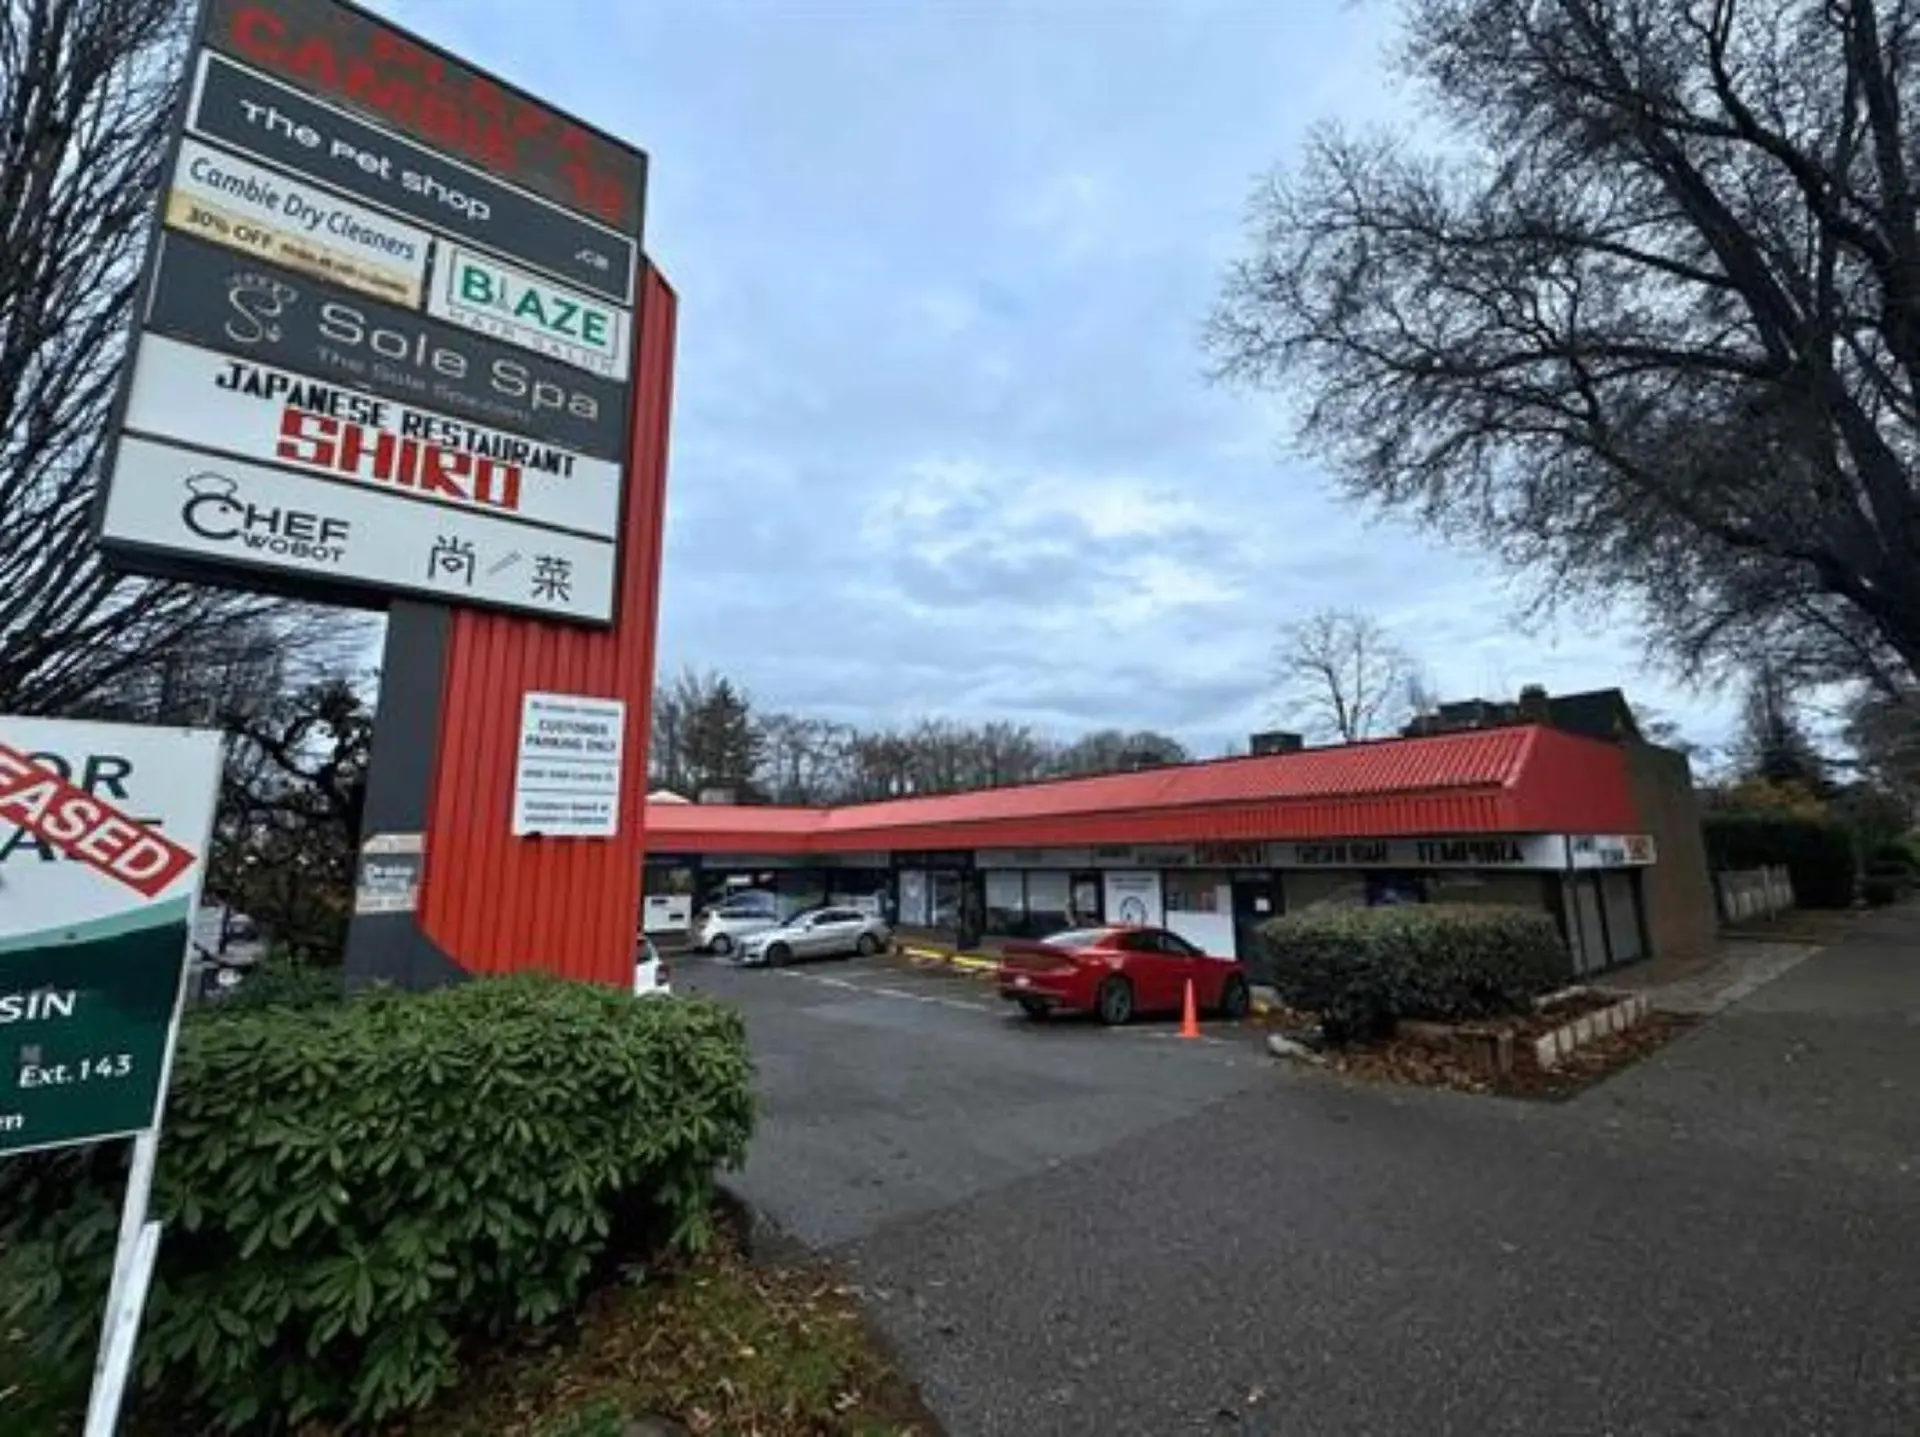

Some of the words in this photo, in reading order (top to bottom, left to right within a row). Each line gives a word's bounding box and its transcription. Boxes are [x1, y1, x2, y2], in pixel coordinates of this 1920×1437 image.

[190, 157, 280, 210] Cambie
[284, 193, 324, 231] Dry
[327, 211, 416, 260] Cleaners
[233, 225, 272, 249] OFF
[318, 302, 468, 379] Sole
[490, 357, 598, 420] Spa
[215, 363, 391, 427] JAPANESE
[402, 409, 577, 479] RESTAURANT
[243, 533, 346, 563] WOBOT
